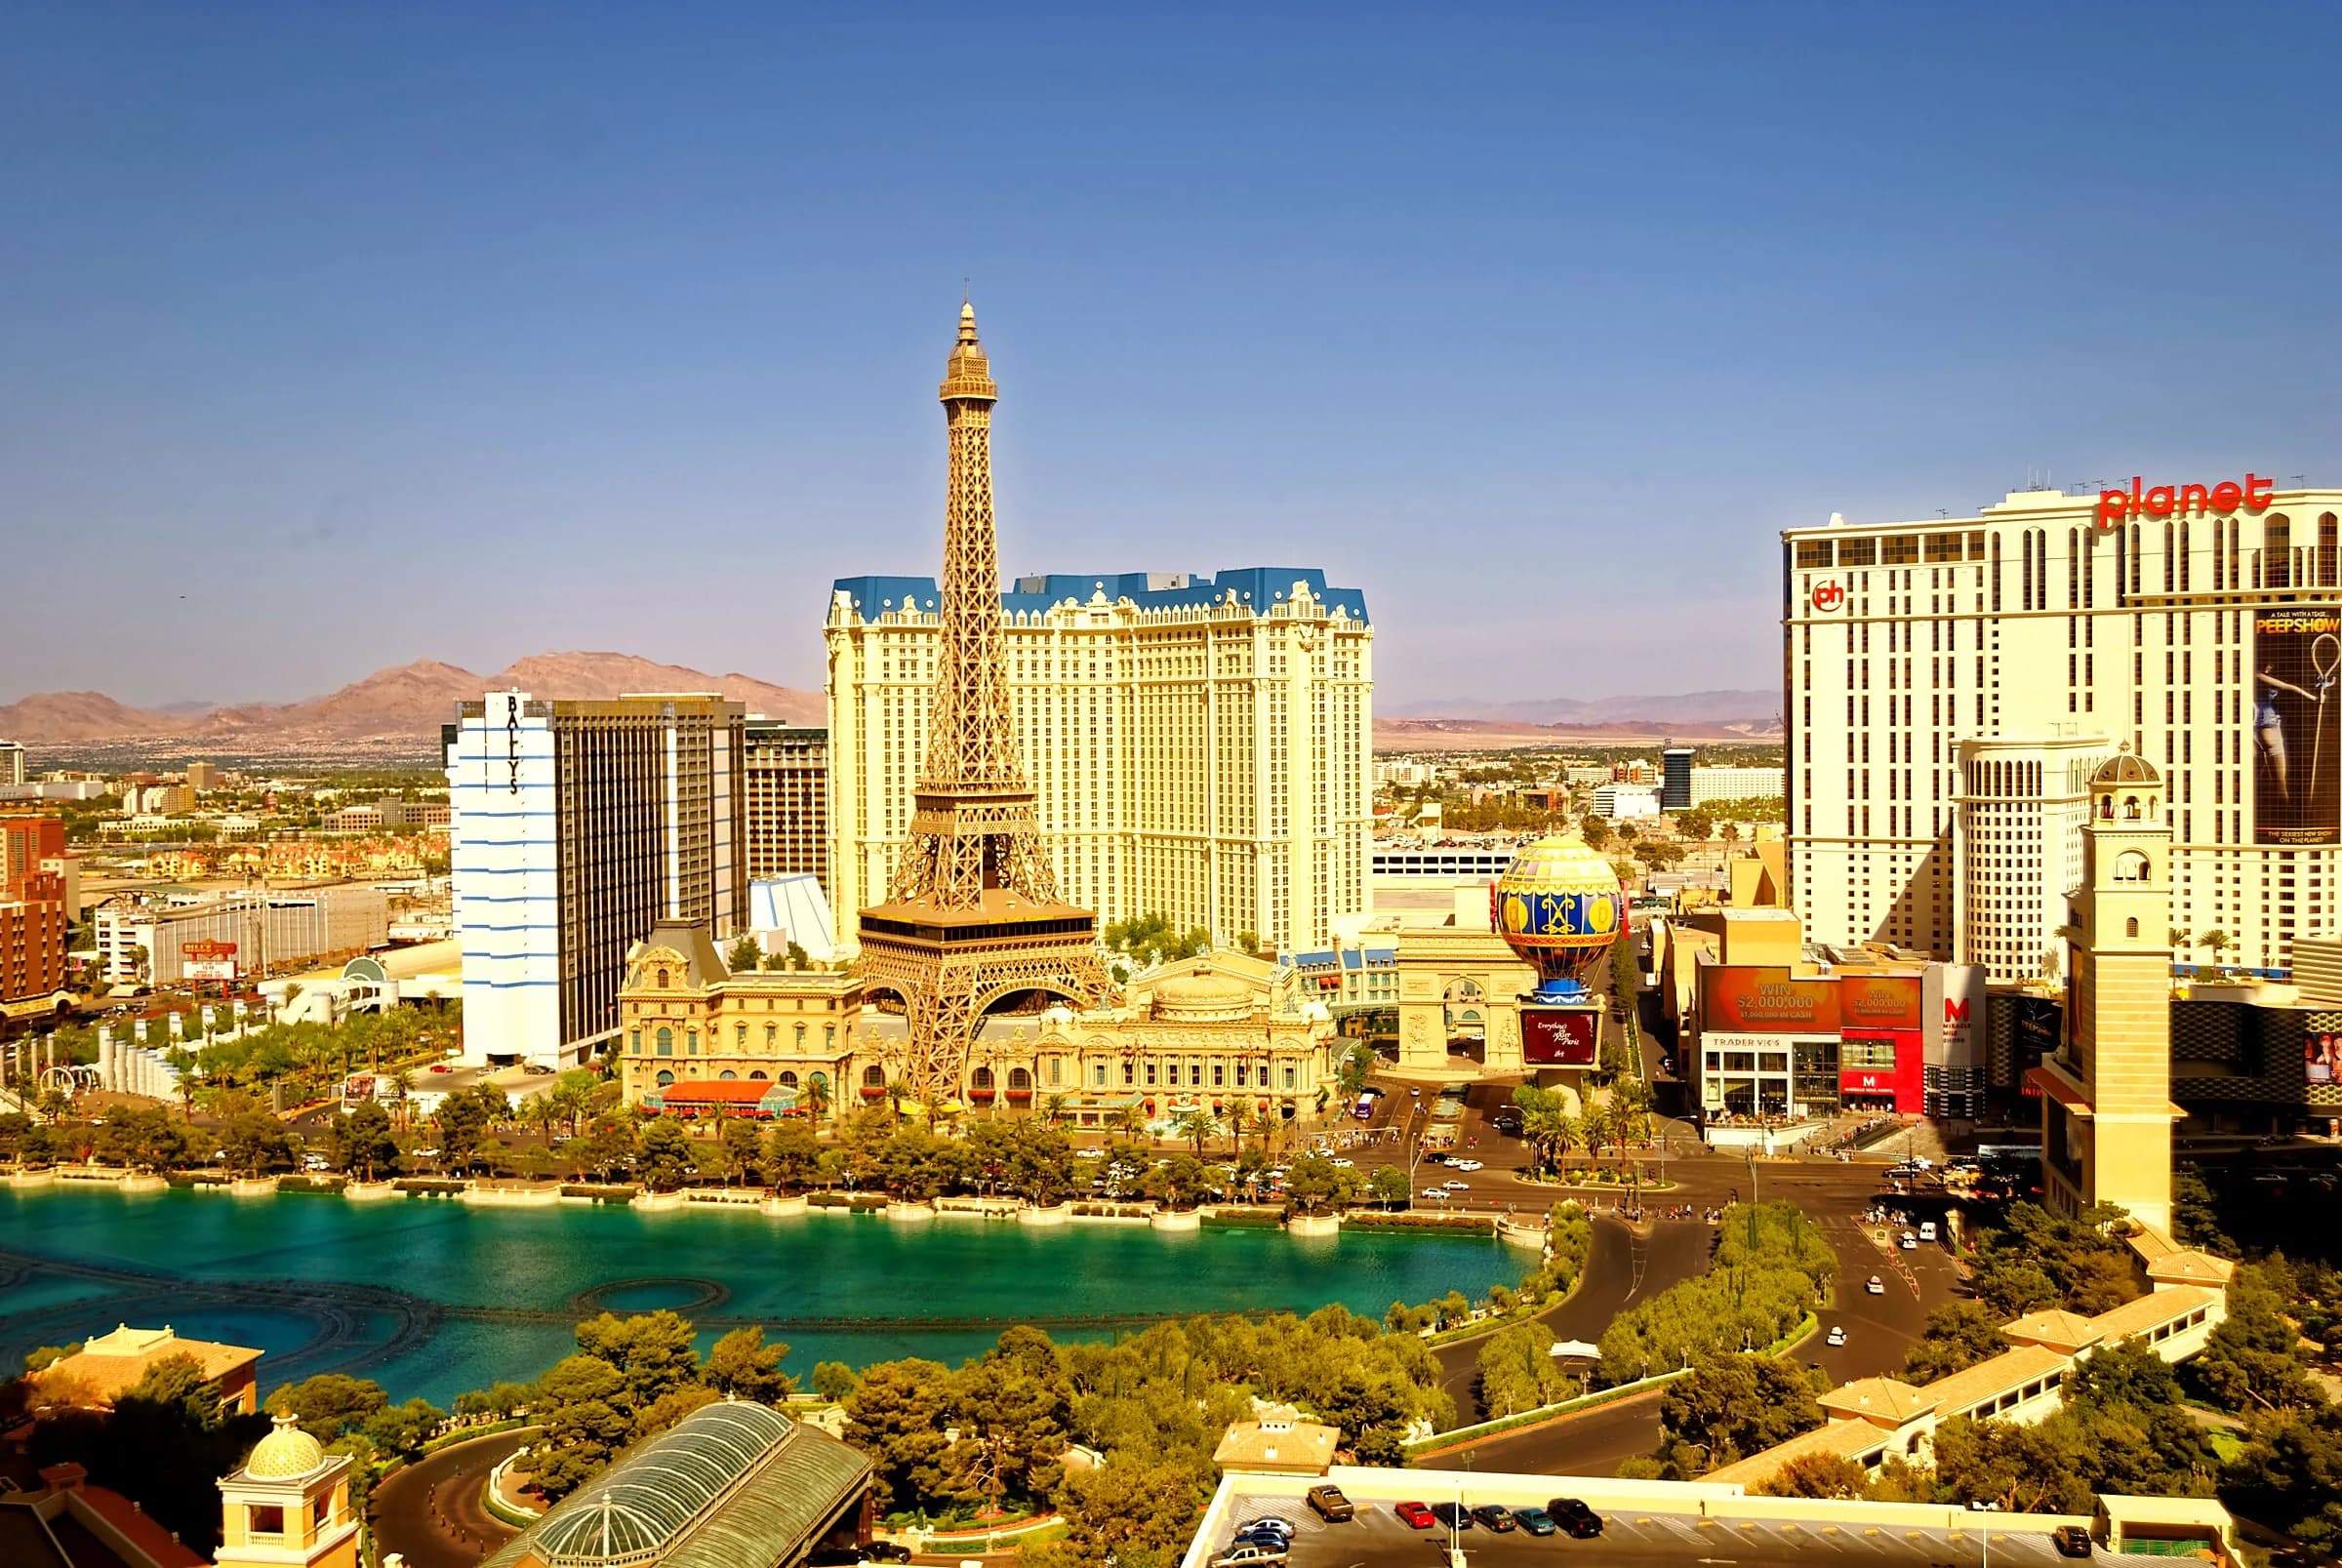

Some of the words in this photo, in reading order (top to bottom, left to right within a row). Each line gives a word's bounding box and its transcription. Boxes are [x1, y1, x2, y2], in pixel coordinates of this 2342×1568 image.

[2099, 472, 2274, 530] planet
[1815, 580, 1844, 610] ph
[2256, 618, 2340, 633] PEEPSHOW
[1759, 984, 1792, 995] WIN
[1738, 995, 1813, 1009] $2,000,000
[1945, 998, 1968, 1022] M
[1863, 1075, 1875, 1086] M
